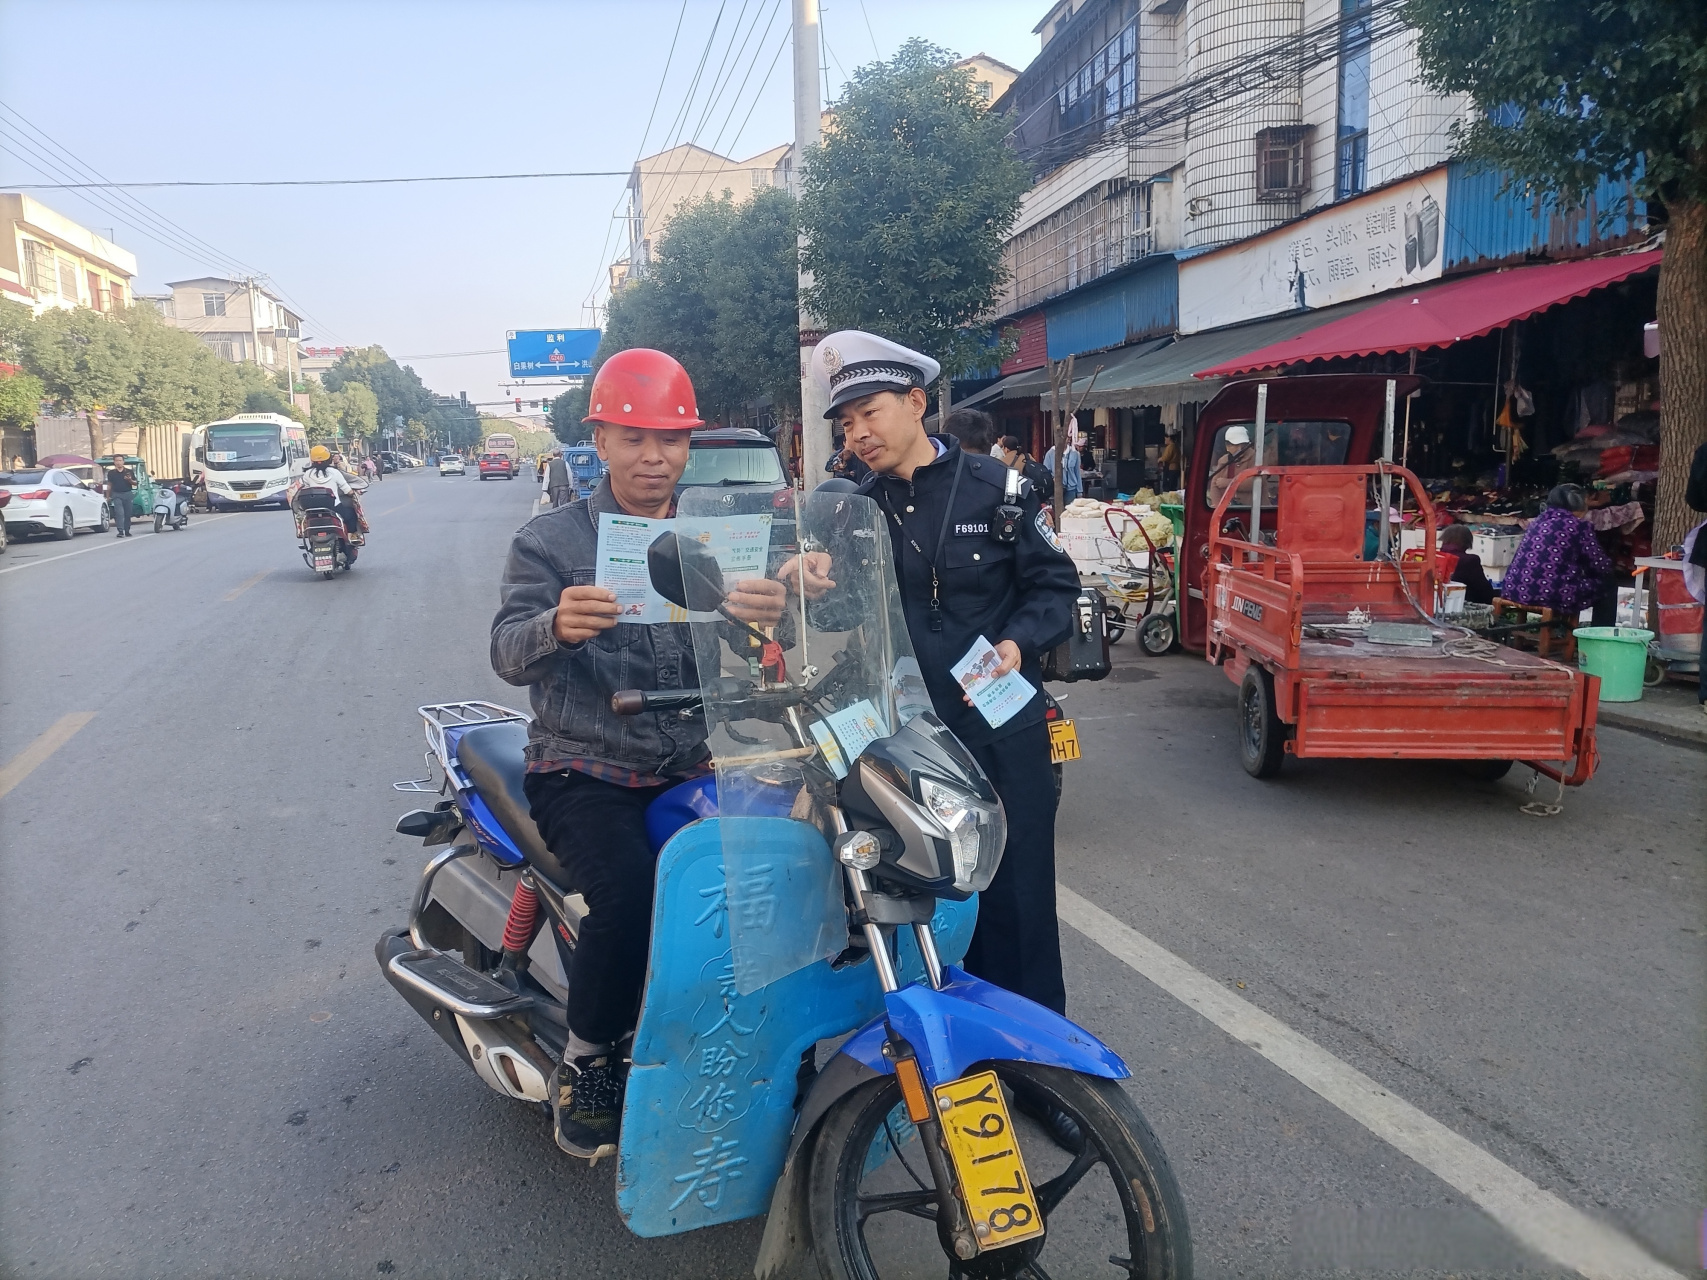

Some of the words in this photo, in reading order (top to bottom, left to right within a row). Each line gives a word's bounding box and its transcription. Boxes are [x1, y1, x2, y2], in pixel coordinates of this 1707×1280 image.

[546, 333, 565, 343] 监利
[513, 361, 534, 371] 白果树
[955, 523, 989, 534] F69101
[693, 862, 780, 938] 福
[668, 1135, 750, 1213] 寿
[954, 1082, 1033, 1233] Y9178
